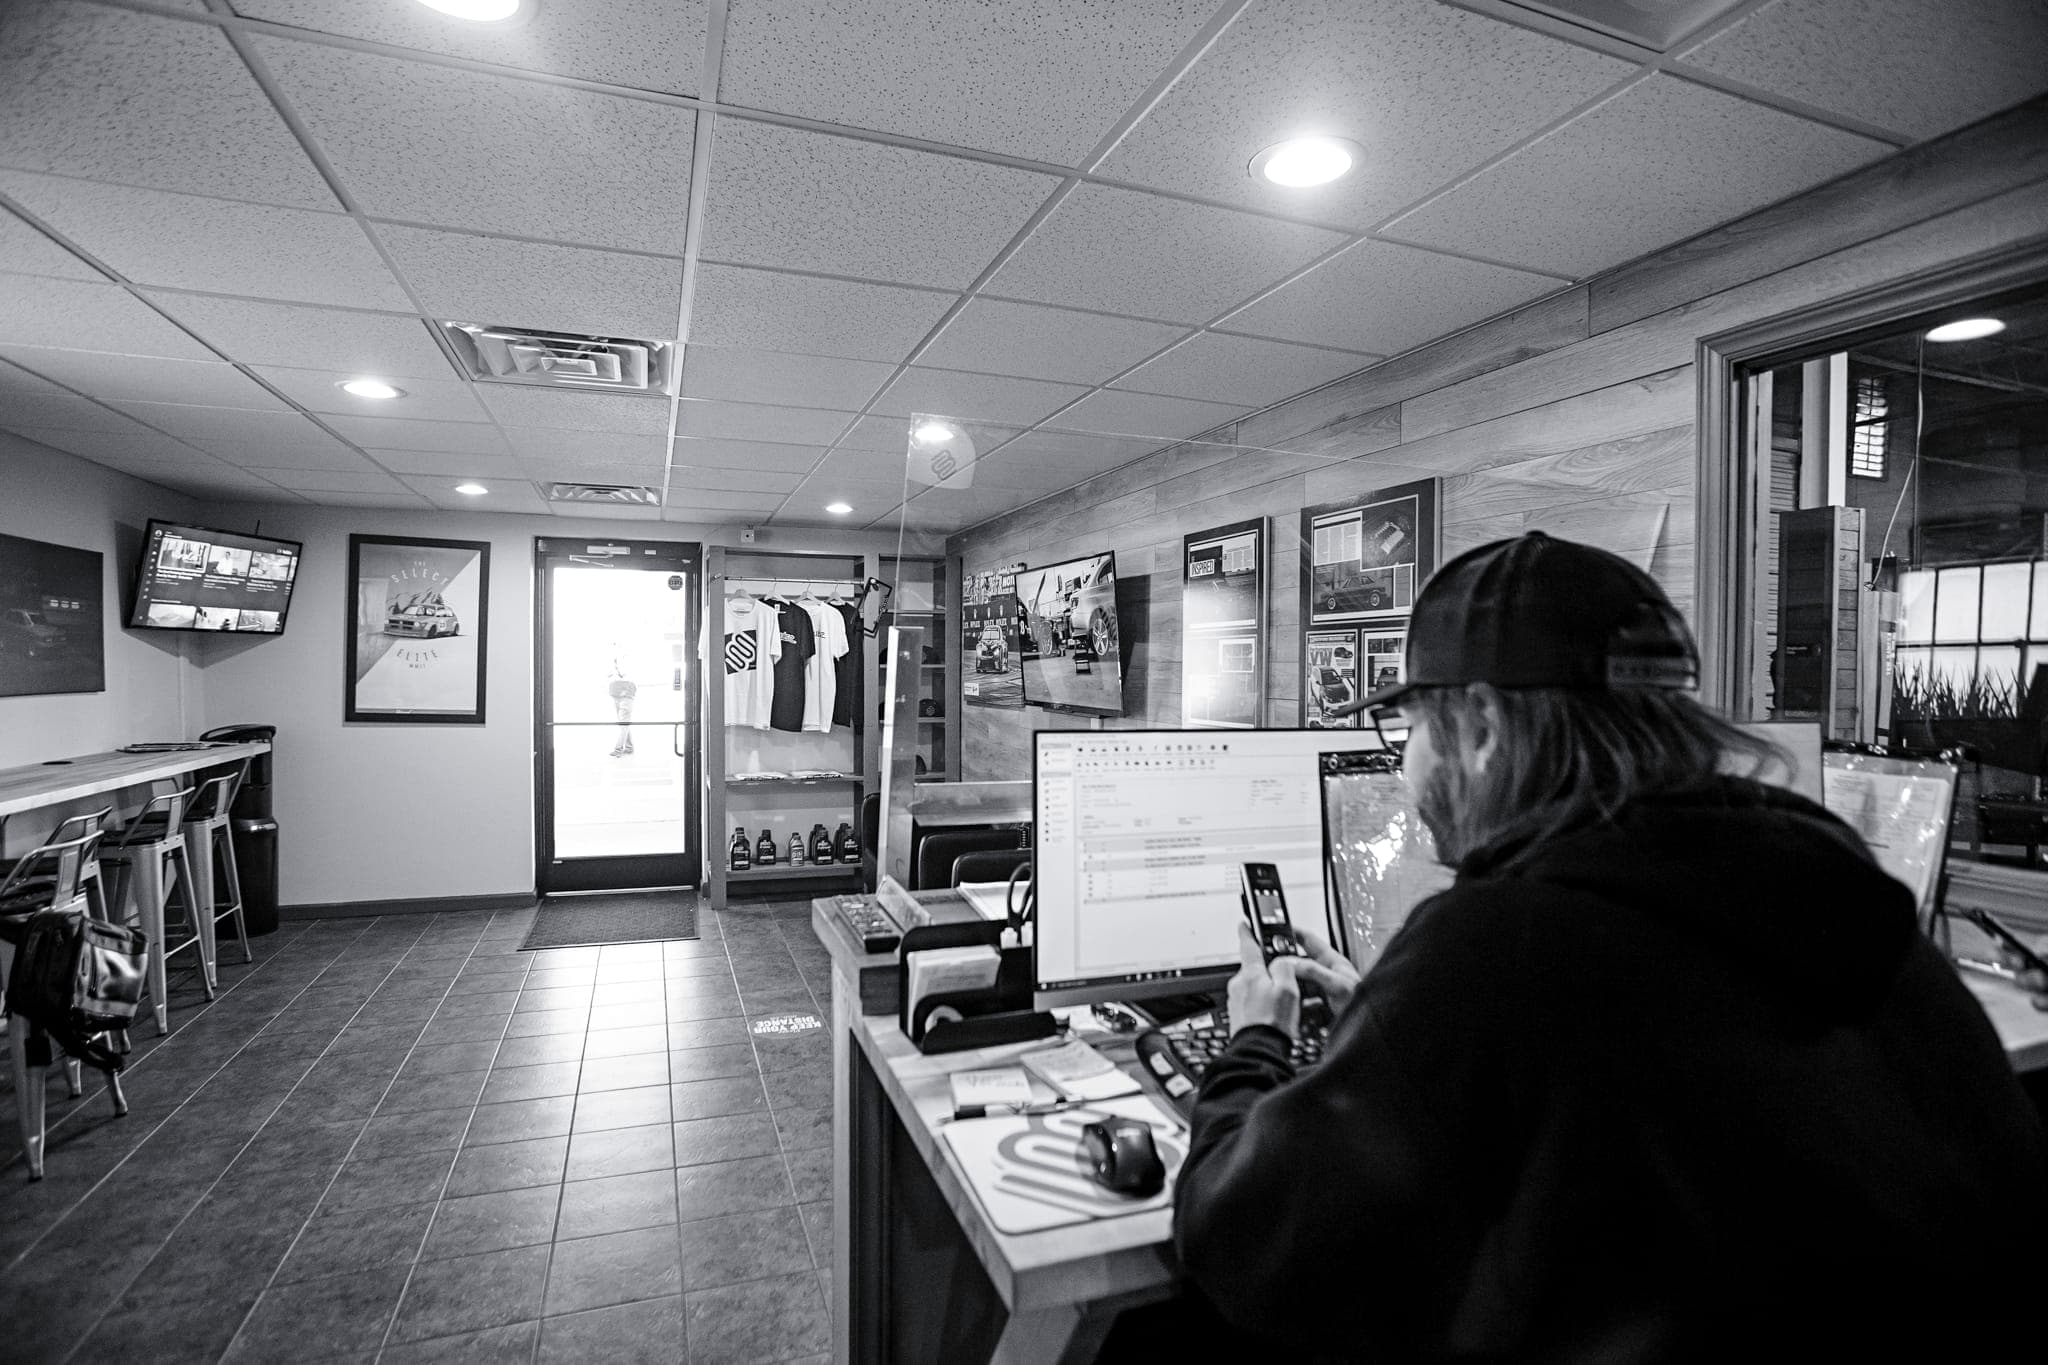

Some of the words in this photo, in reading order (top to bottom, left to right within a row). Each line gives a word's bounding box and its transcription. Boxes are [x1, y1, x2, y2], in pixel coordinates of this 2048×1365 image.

[391, 568, 449, 585] SELECT
[397, 648, 438, 661] ELITE
[1310, 647, 1332, 666] VW
[754, 1024, 789, 1034] YOUR
[789, 1020, 821, 1030] KEEP
